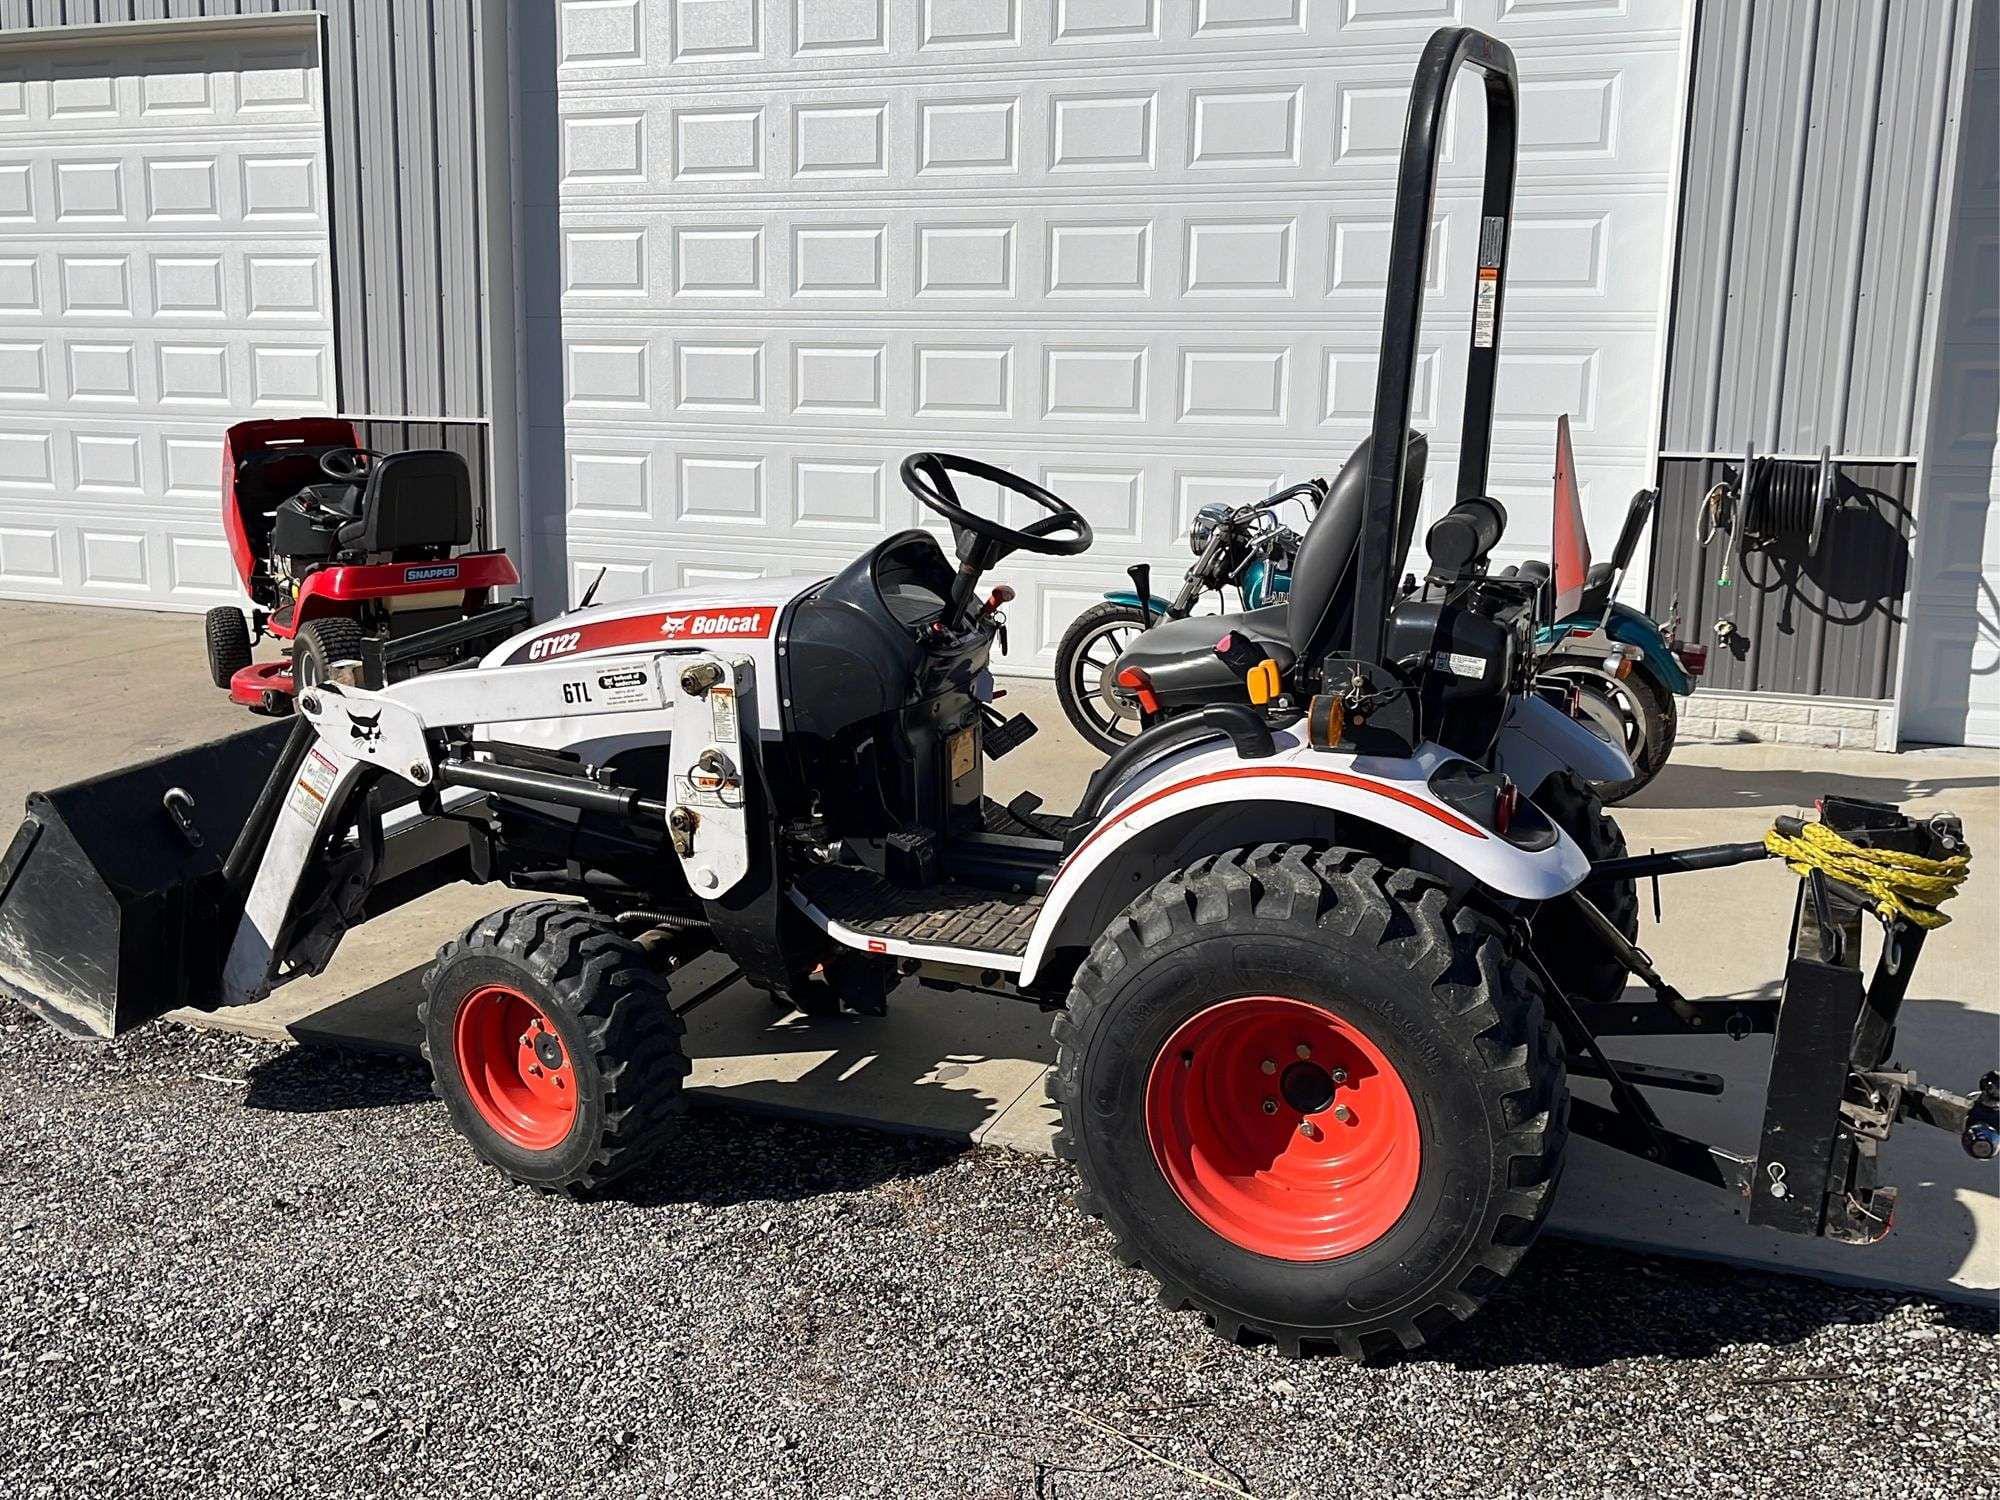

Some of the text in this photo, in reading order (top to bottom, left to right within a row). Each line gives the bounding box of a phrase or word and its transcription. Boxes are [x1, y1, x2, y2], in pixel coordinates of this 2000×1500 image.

[408, 568, 455, 580] SNAPPER
[691, 613, 760, 634] Bobcat
[529, 632, 580, 660] CT122
[563, 681, 592, 704] 6TL
